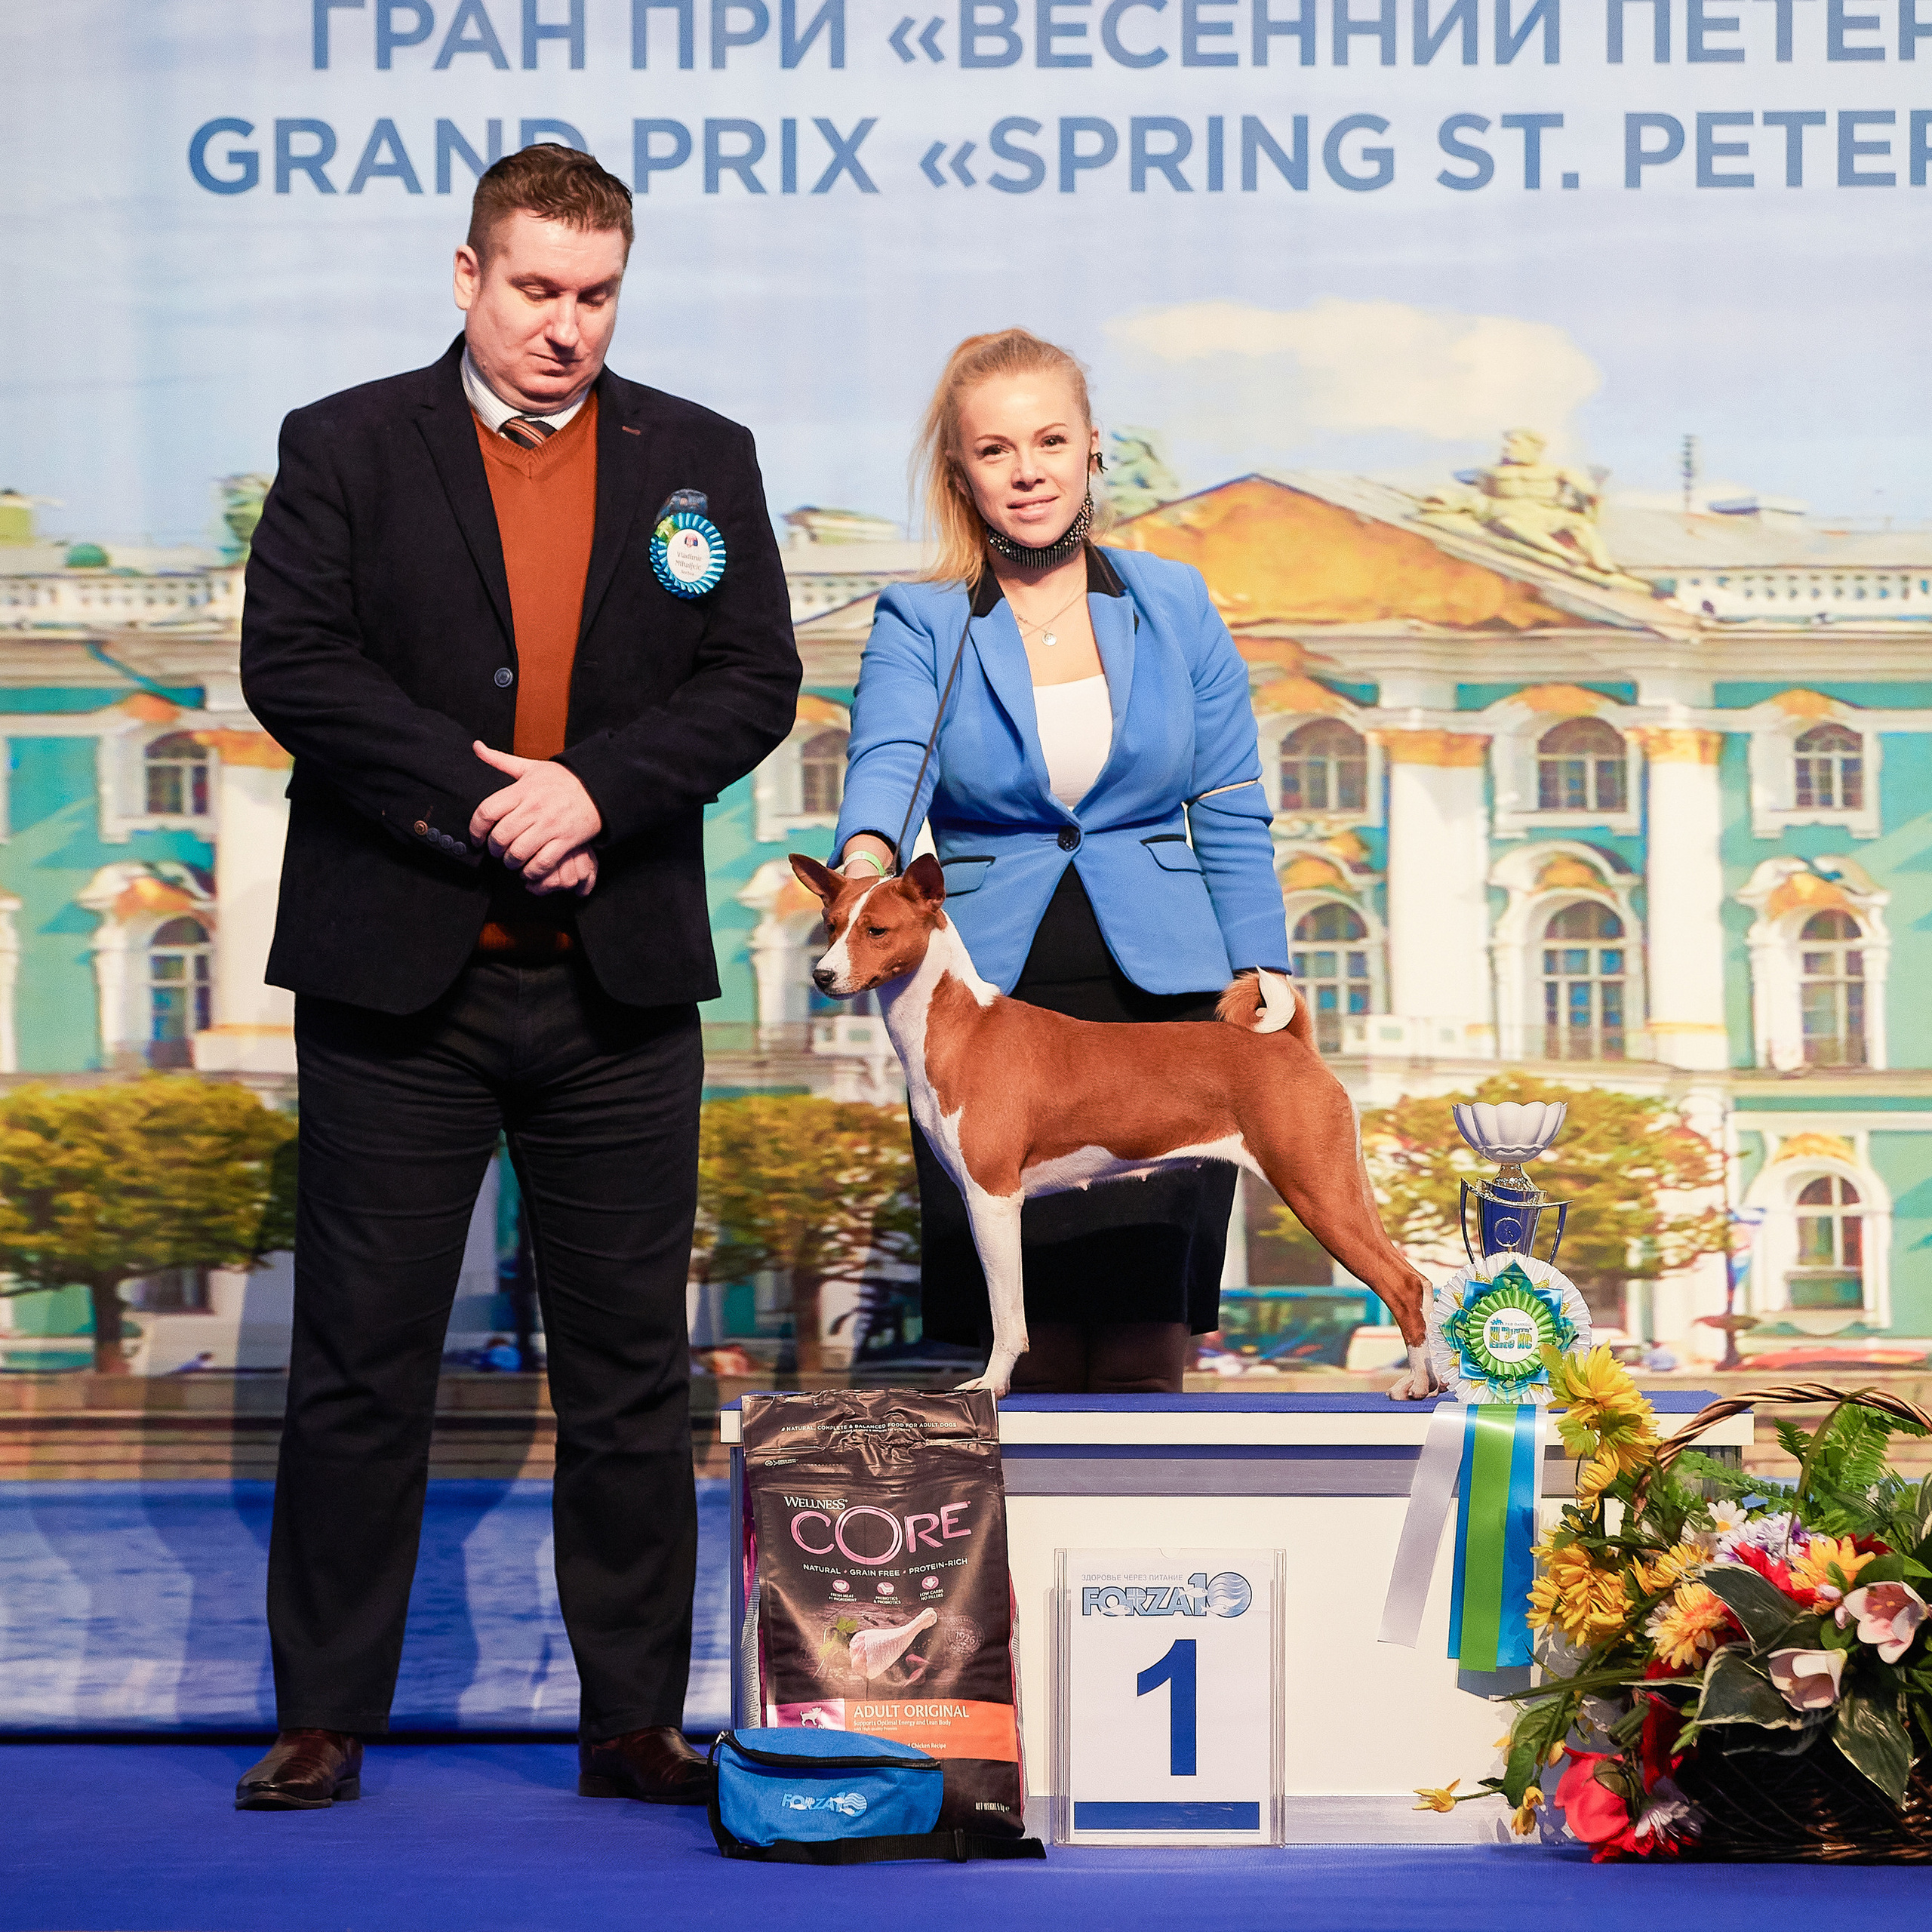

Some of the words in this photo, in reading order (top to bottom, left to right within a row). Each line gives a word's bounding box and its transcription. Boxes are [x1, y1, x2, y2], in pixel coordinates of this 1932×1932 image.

[309, 0, 586, 70] ГРАН
[631, 0, 846, 70] ПРИ
[632, 116, 880, 194] PRIX
[1435, 112, 1580, 192] ST.
[790, 1500, 972, 1566] CORE
[803, 1564, 841, 1575] NATURAL
[909, 1557, 968, 1575] PROTEIN-RICH
[1081, 1574, 1121, 1582] ЗДОРОВЬЕ
[955, 1631, 976, 1644] 1926
[854, 1705, 901, 1718] ADULT
[903, 1704, 970, 1718] ORIGINAL
[1137, 1638, 1197, 1777] 1
